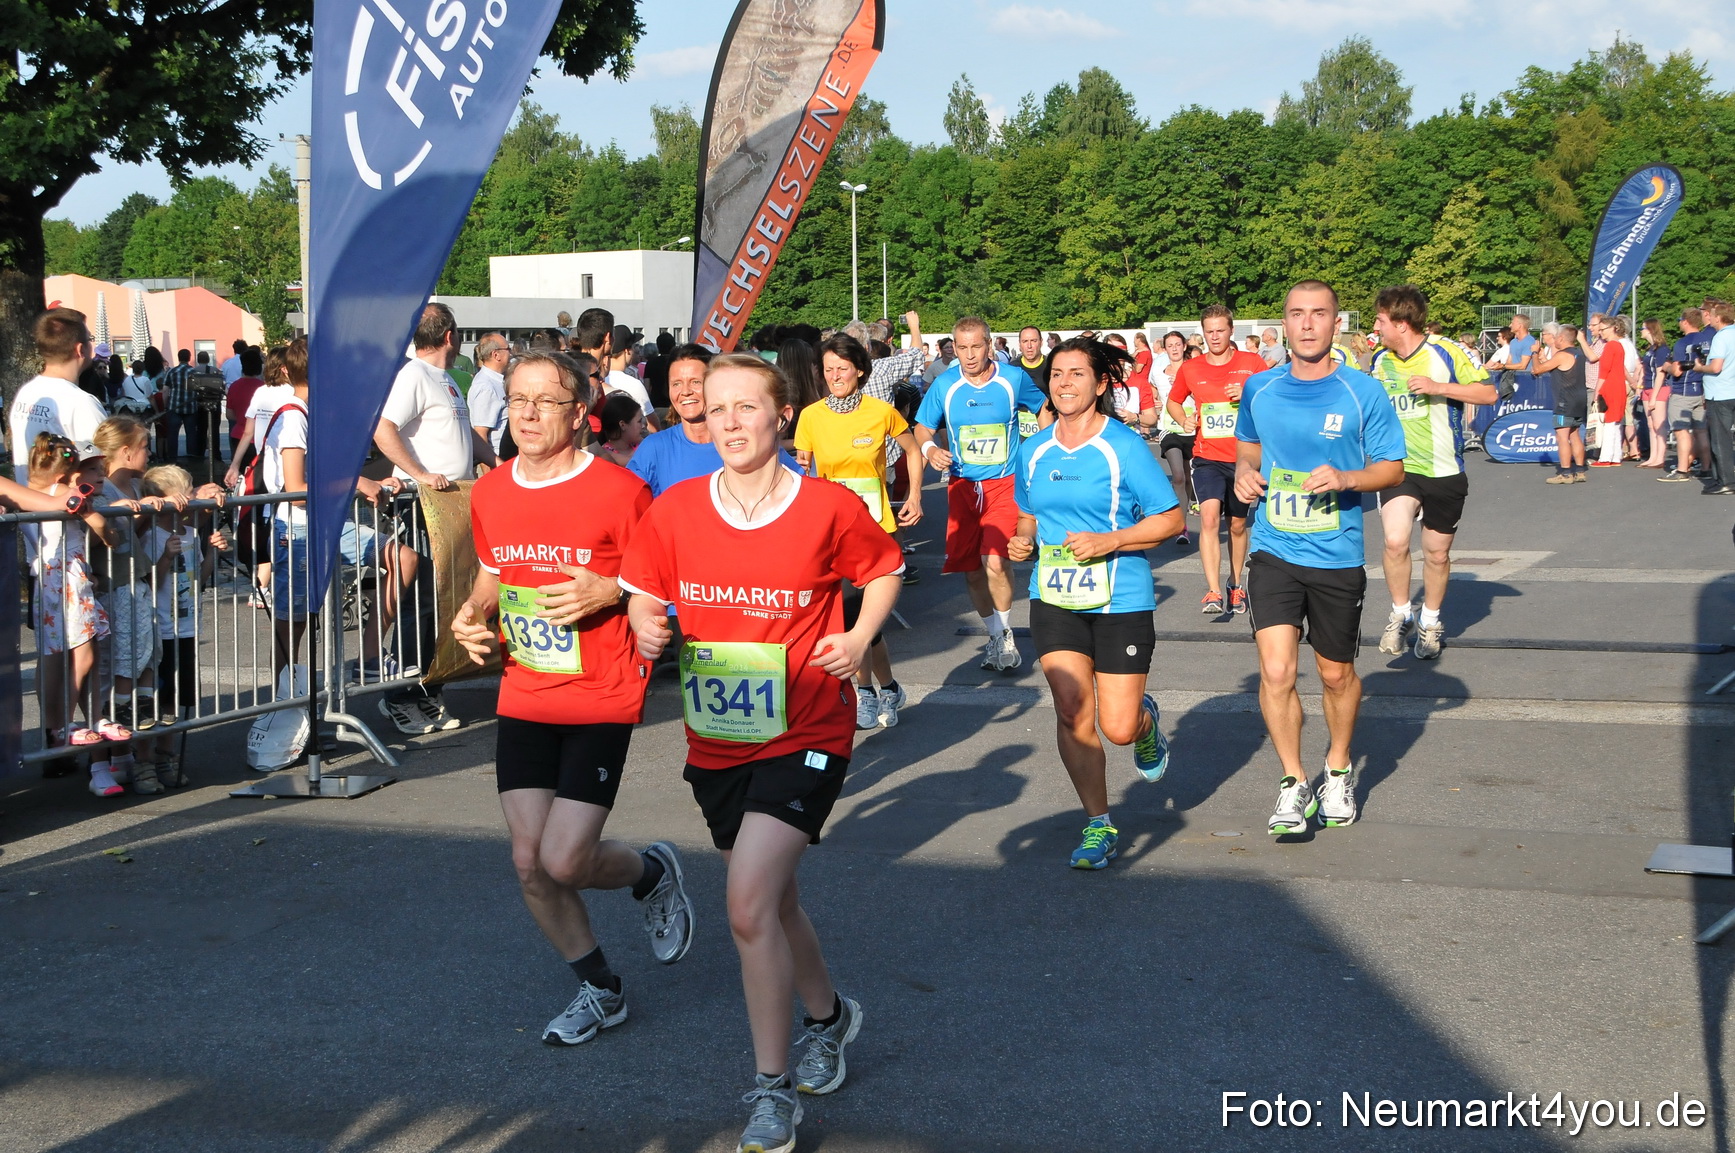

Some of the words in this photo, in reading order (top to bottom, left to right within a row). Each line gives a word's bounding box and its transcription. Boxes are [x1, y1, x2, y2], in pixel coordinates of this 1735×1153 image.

[1593, 207, 1655, 293] Frischmann
[1497, 399, 1545, 417] Fisch
[1019, 423, 1039, 434] 506
[1206, 414, 1235, 430] 945
[966, 438, 999, 455] 477
[1270, 491, 1331, 518] 1171
[532, 565, 553, 573] STARKE
[1046, 567, 1097, 593] 474
[679, 580, 795, 608] NEUMARKT
[742, 609, 769, 619] STARKE
[770, 613, 793, 621] STADT
[502, 613, 574, 652] 1339
[684, 675, 775, 718] 1341
[711, 716, 730, 725] Annika
[719, 726, 743, 734] Neumarkt
